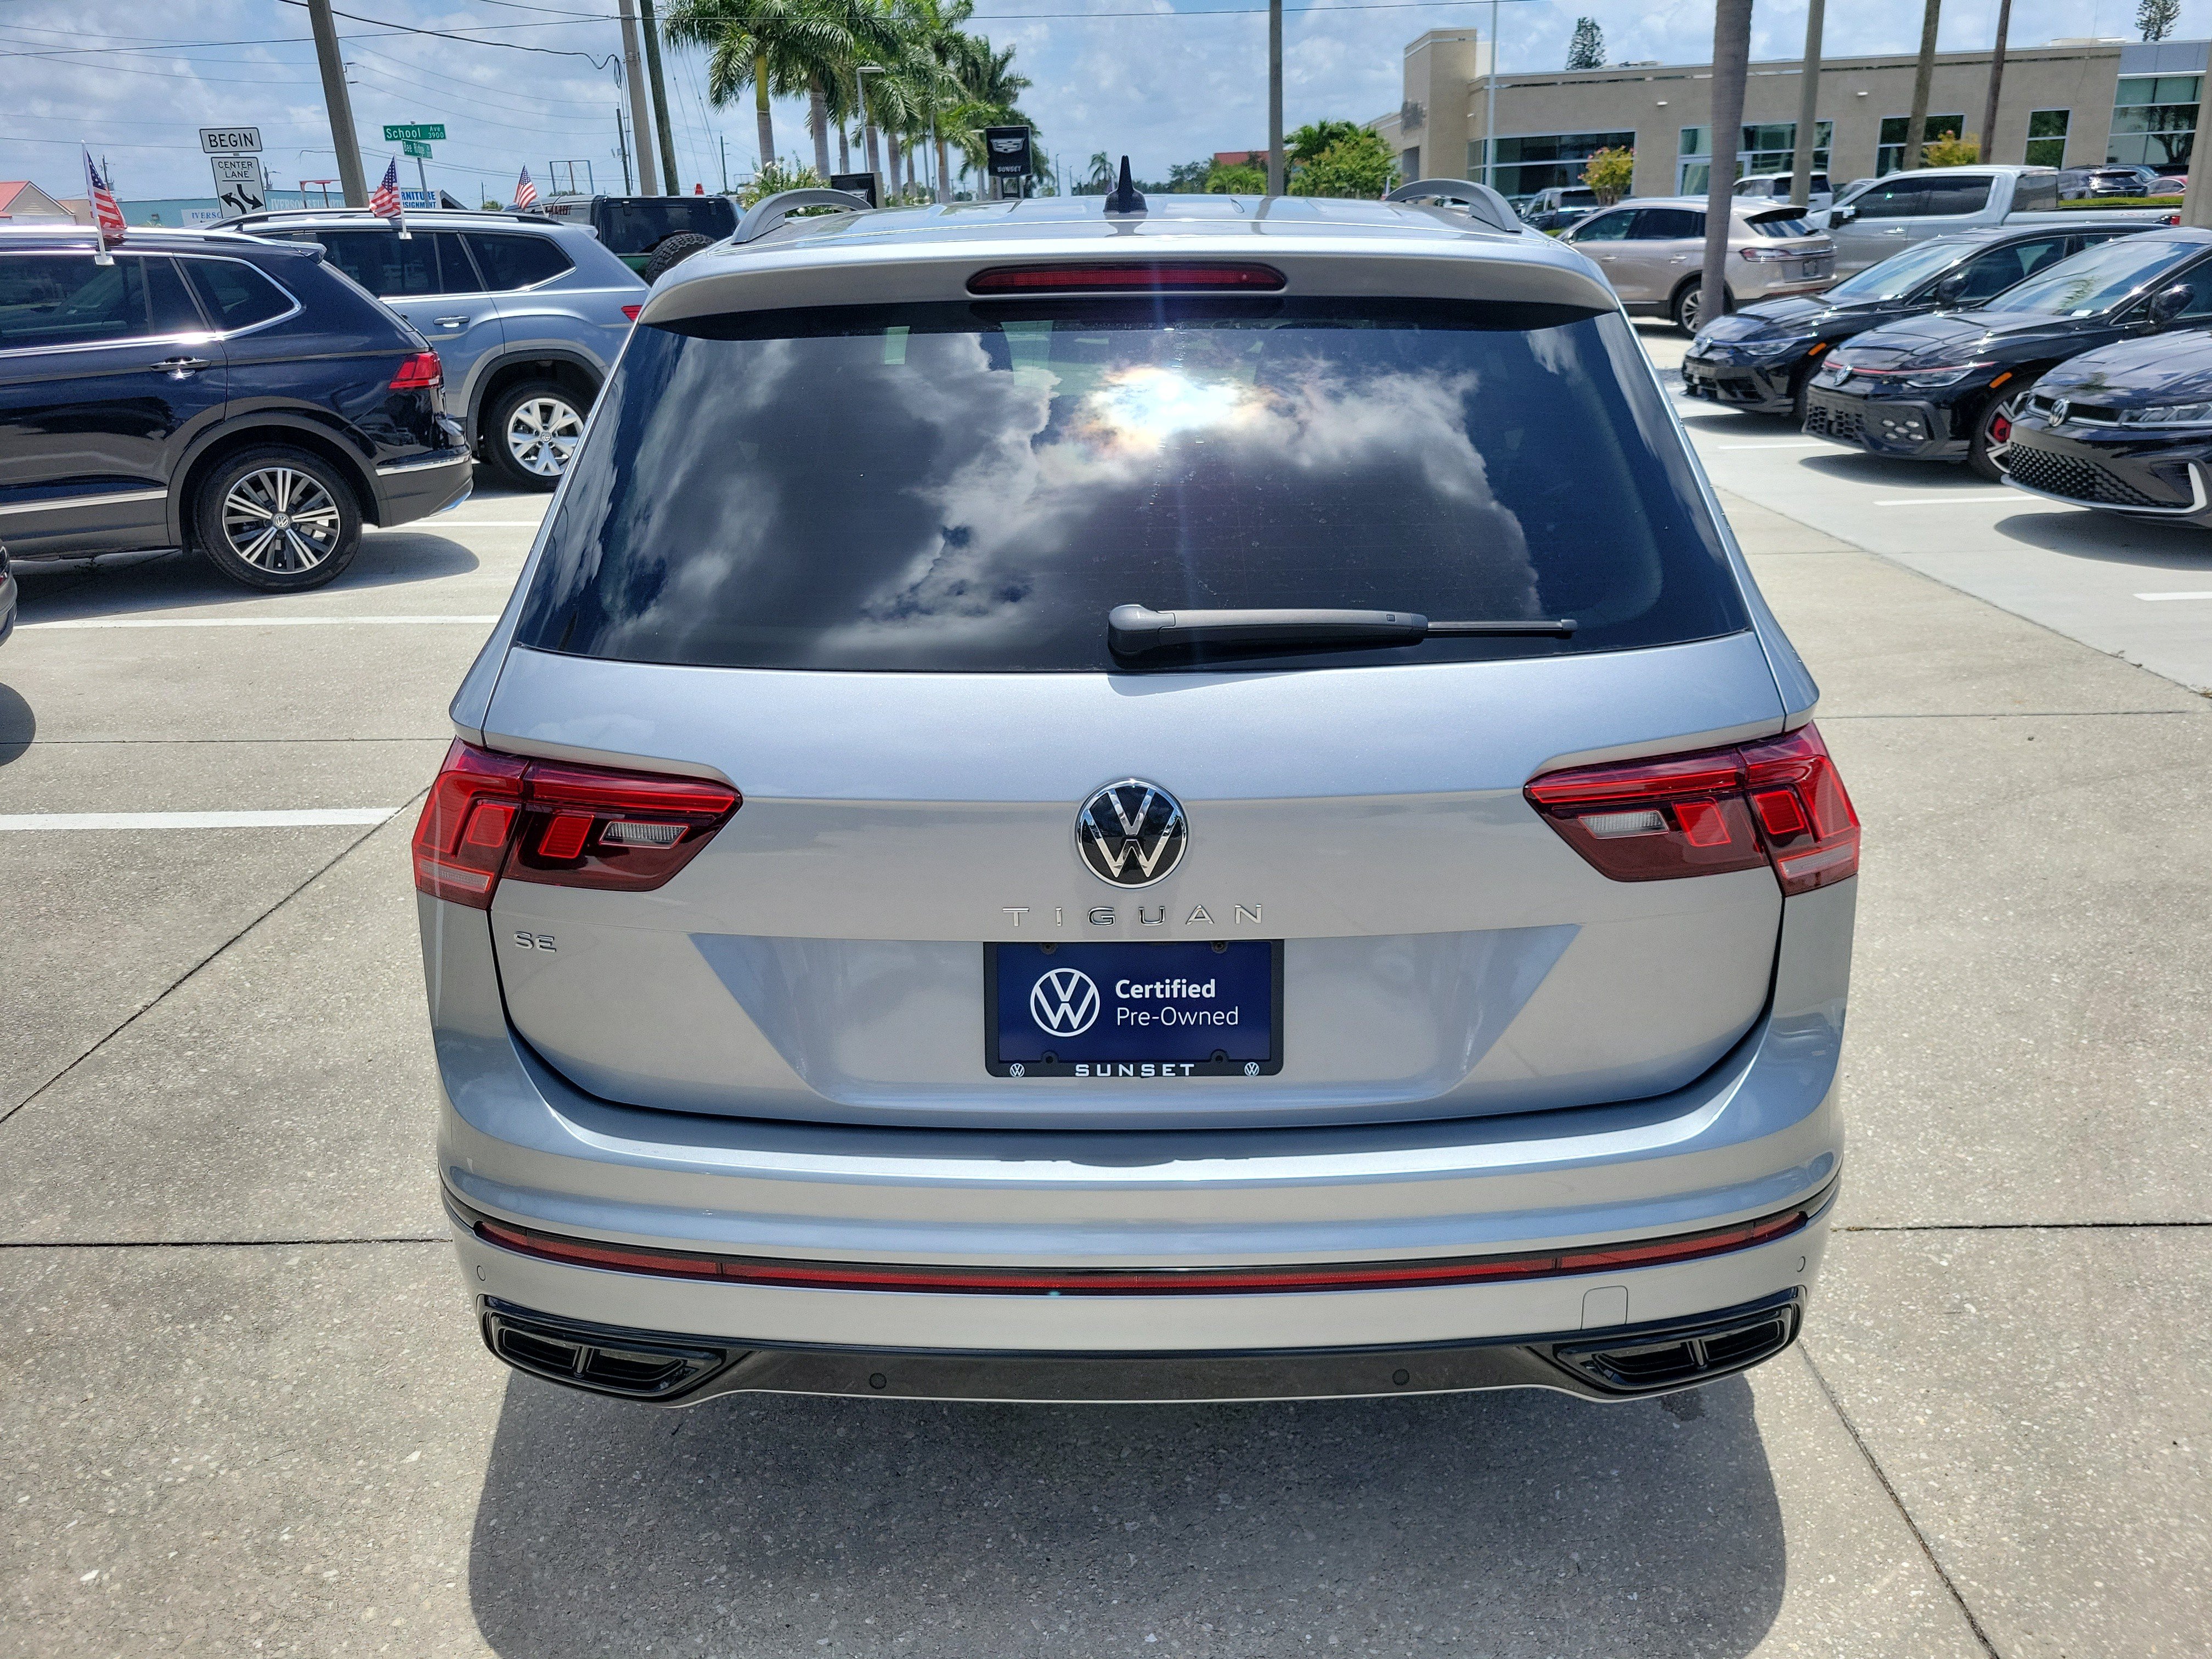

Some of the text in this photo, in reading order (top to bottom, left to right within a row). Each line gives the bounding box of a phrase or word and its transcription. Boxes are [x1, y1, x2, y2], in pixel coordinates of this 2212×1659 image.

[208, 133, 254, 148] BEGIN
[386, 127, 421, 138] School
[401, 191, 436, 201] RNITURE
[1002, 904, 1263, 927] TIGUAN
[514, 931, 557, 952] SE
[1115, 979, 1216, 998] Certified
[1117, 1006, 1238, 1025] Pre-Owned
[1075, 1063, 1195, 1076] SUNSET
